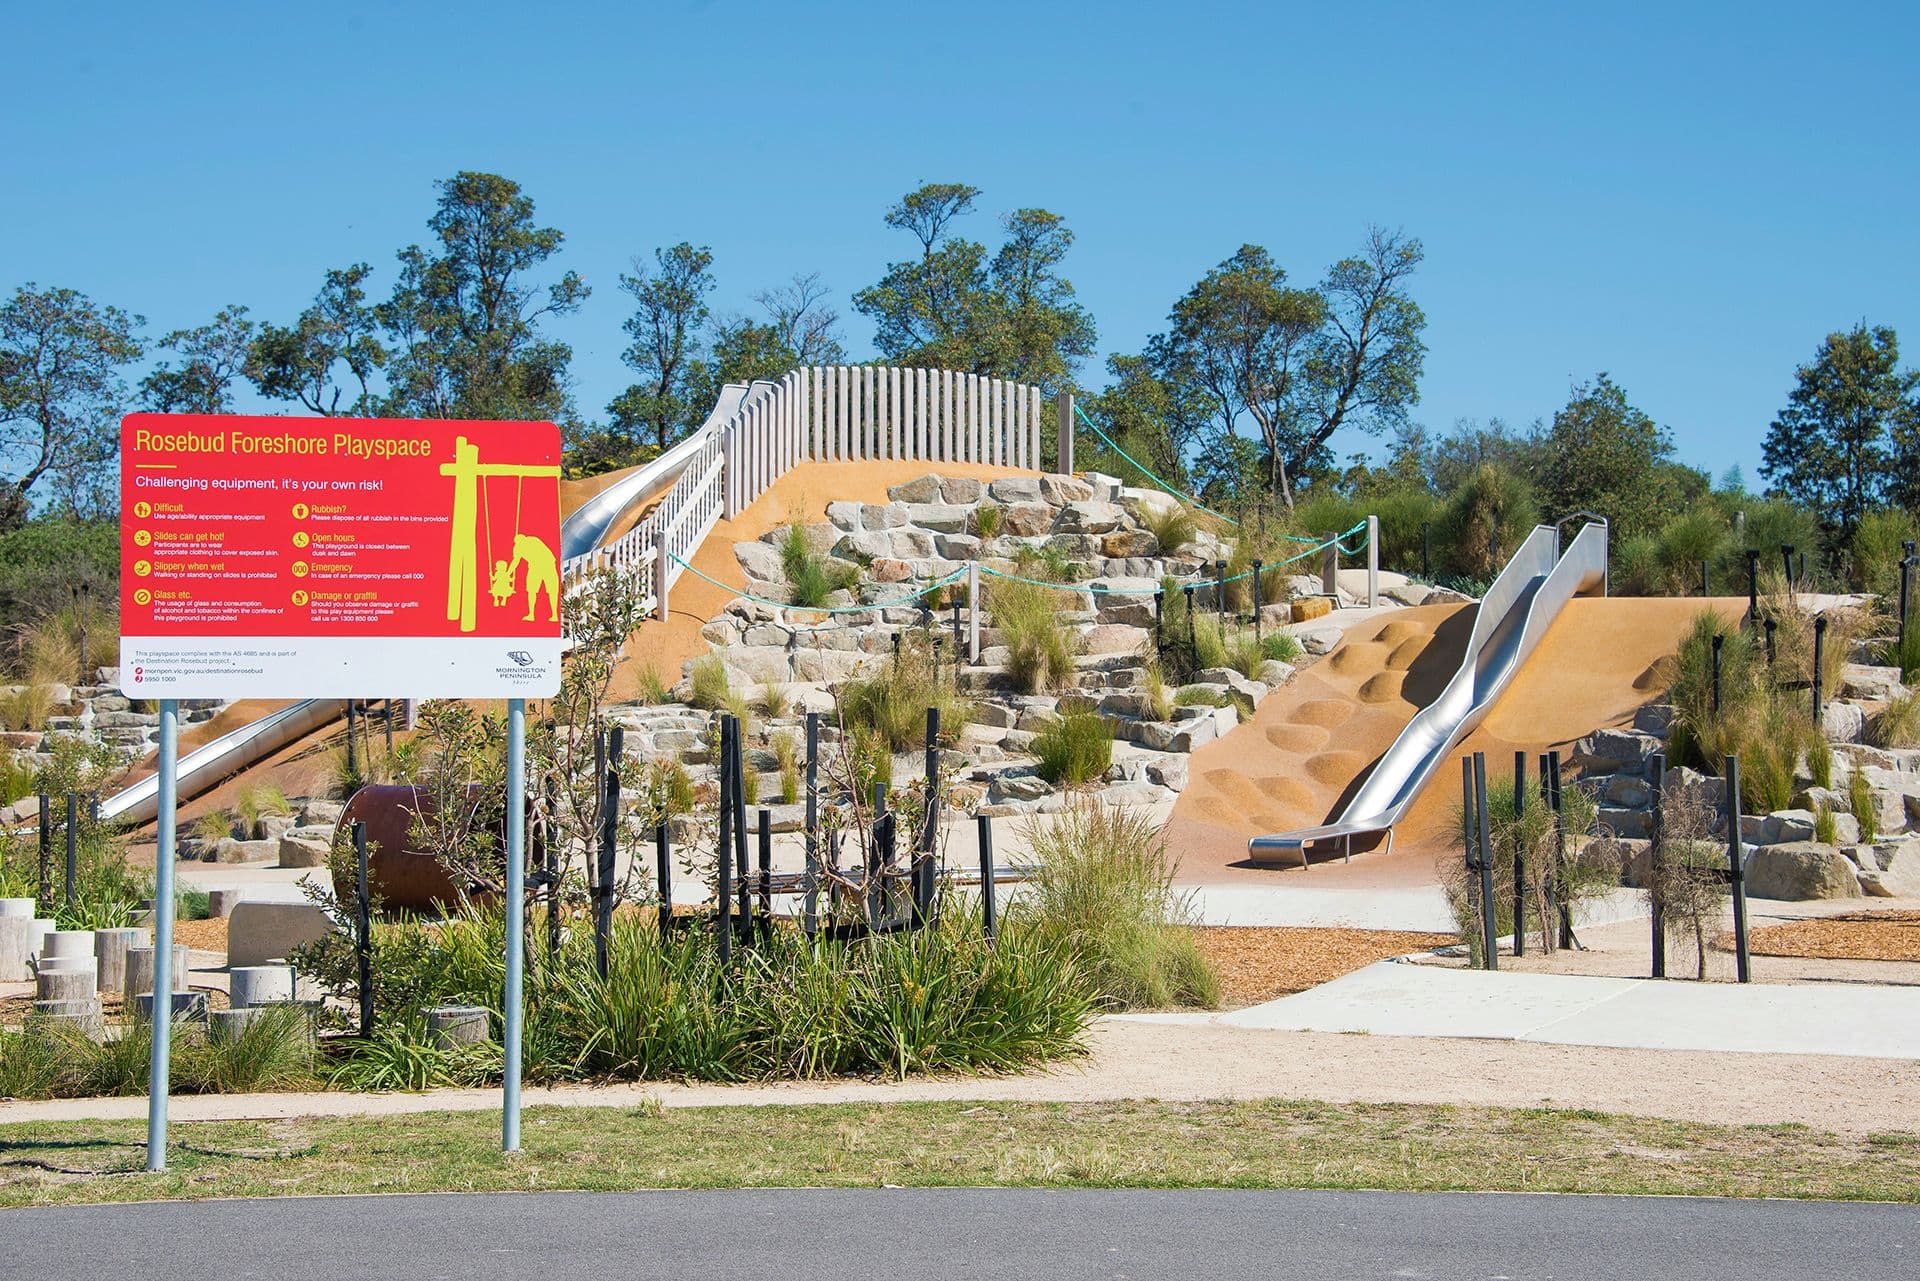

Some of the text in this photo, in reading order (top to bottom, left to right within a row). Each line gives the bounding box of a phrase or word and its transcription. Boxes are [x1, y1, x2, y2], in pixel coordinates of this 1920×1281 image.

[136, 430, 431, 460] Rosebud Foreshore Playspace
[136, 476, 208, 490] Challenging
[212, 478, 278, 490] equipment,
[302, 480, 328, 492] your
[331, 481, 356, 490] own
[359, 480, 383, 490] risk!
[154, 503, 183, 512] Difficult
[154, 532, 177, 540] Slides
[196, 533, 208, 542] get
[210, 532, 224, 540] hot!
[312, 533, 331, 543] Open
[154, 562, 185, 572] Slippery
[312, 563, 353, 573] Emergency
[154, 590, 176, 599] Glass
[312, 592, 342, 602] Damage
[354, 592, 377, 601] graffiti
